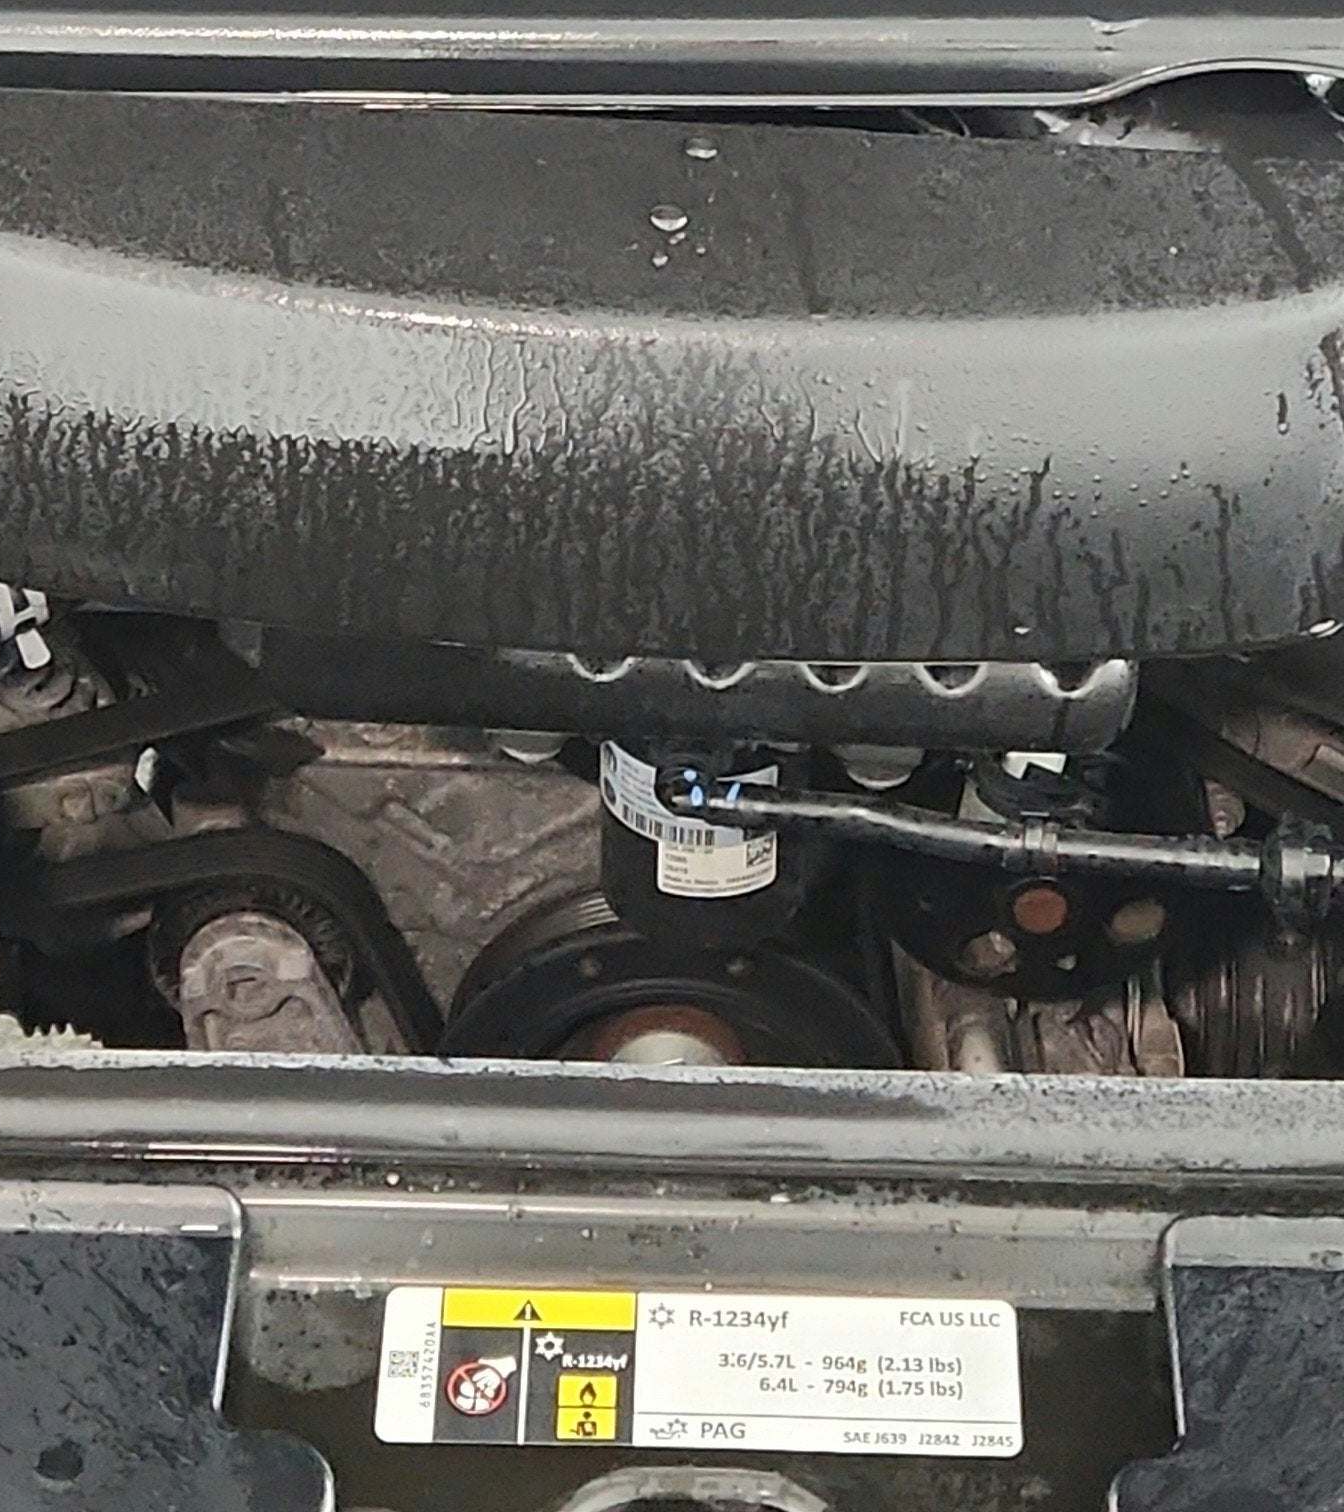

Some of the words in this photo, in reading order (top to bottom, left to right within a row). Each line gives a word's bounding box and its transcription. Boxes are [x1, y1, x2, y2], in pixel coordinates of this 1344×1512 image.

[689, 1310, 789, 1333] R-1234yf
[899, 1311, 935, 1326] FCA
[939, 1312, 964, 1327] US
[970, 1312, 1001, 1327] LLC
[718, 1352, 796, 1371] 3.6/5.7L
[822, 1355, 867, 1375] 964g
[877, 1355, 924, 1375] (2.13
[929, 1357, 962, 1376] lbs)
[759, 1377, 798, 1392] 6.4L
[823, 1379, 868, 1398] 794g
[878, 1379, 925, 1398] (1.75
[930, 1381, 963, 1400] lbs)
[701, 1422, 747, 1439] PAG
[843, 1432, 871, 1444] SAE
[874, 1432, 907, 1445] J639
[918, 1433, 961, 1446] J2842
[972, 1435, 1013, 1448] J2845
